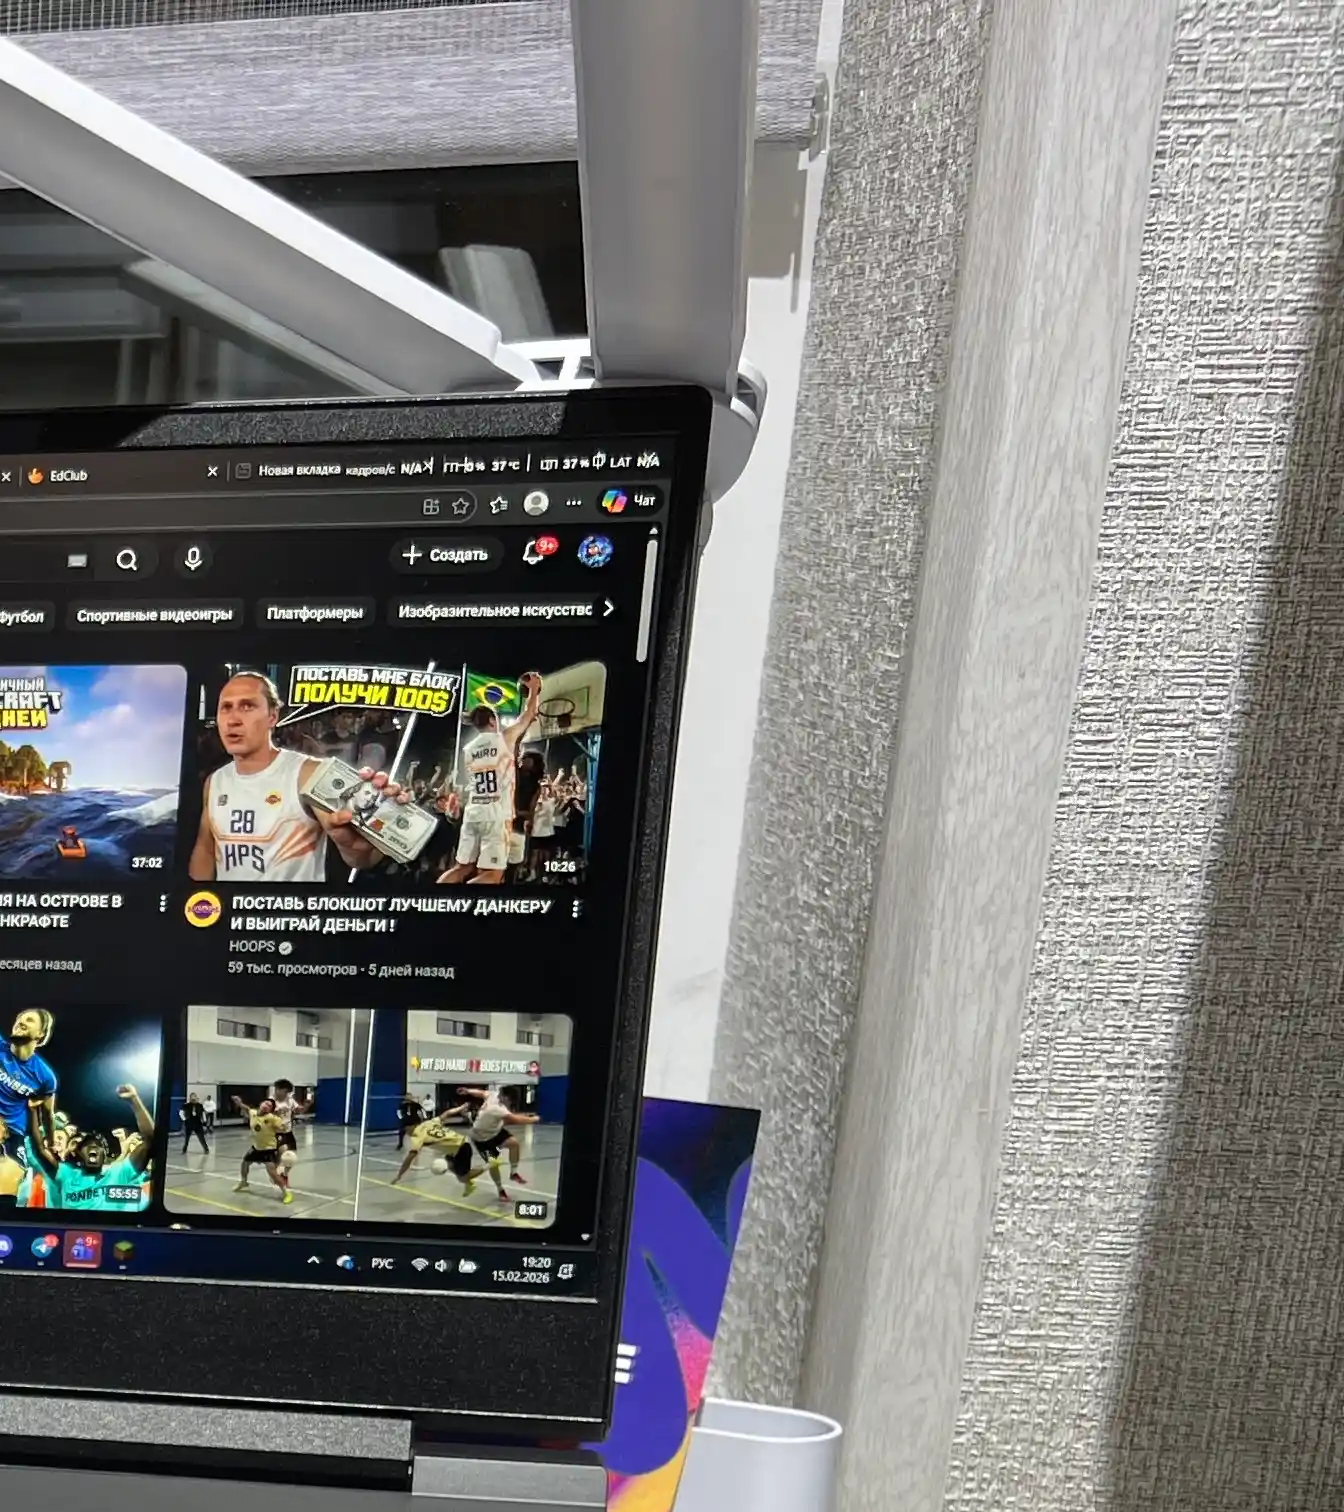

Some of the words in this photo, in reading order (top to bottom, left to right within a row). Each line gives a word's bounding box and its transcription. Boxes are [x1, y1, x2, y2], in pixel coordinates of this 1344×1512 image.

[50, 469, 88, 482] EdClub
[258, 464, 294, 477] Новая
[297, 464, 341, 477] вкладка
[634, 493, 656, 507] Чат
[429, 547, 488, 564] Создать
[77, 609, 158, 625] Спортивные
[160, 607, 233, 625] видеоигры
[267, 606, 363, 623] Платформеры
[398, 604, 519, 621] Изобразительное
[296, 667, 368, 682] ПОСТАВЬ
[371, 669, 407, 686] МНЕ
[294, 683, 389, 705] ПОЛУЧИ
[394, 687, 449, 713] 100$
[230, 809, 254, 834] 28
[131, 856, 163, 869] 37:02
[224, 844, 266, 875] HPS
[543, 860, 576, 873] 10:26
[15, 892, 38, 908] НА
[40, 892, 109, 908] ОСТРОВЕ
[111, 893, 122, 908] В
[232, 895, 304, 911] ПОСТАВЬ
[307, 896, 386, 912] БЛОКШОТ
[389, 898, 471, 914] ЛУЧШЕМУ
[474, 899, 551, 916] ДАНКЕРУ
[230, 917, 242, 931] И
[245, 914, 320, 932] ВЫИГРАЙ
[323, 918, 386, 935] ДЕНЬГИ
[229, 940, 275, 954] HOOPS
[45, 959, 83, 973] назад
[228, 961, 243, 975] 59
[246, 963, 275, 976] тыс.
[277, 964, 358, 979] просмотров
[368, 964, 377, 977] 5
[379, 965, 411, 980] дней
[415, 967, 455, 980] назад
[108, 1188, 139, 1200] 55:55
[518, 1204, 543, 1216] 8:01
[372, 1257, 394, 1270] РУС
[522, 1256, 552, 1270] 19:20
[492, 1270, 551, 1285] 15.02.2026
